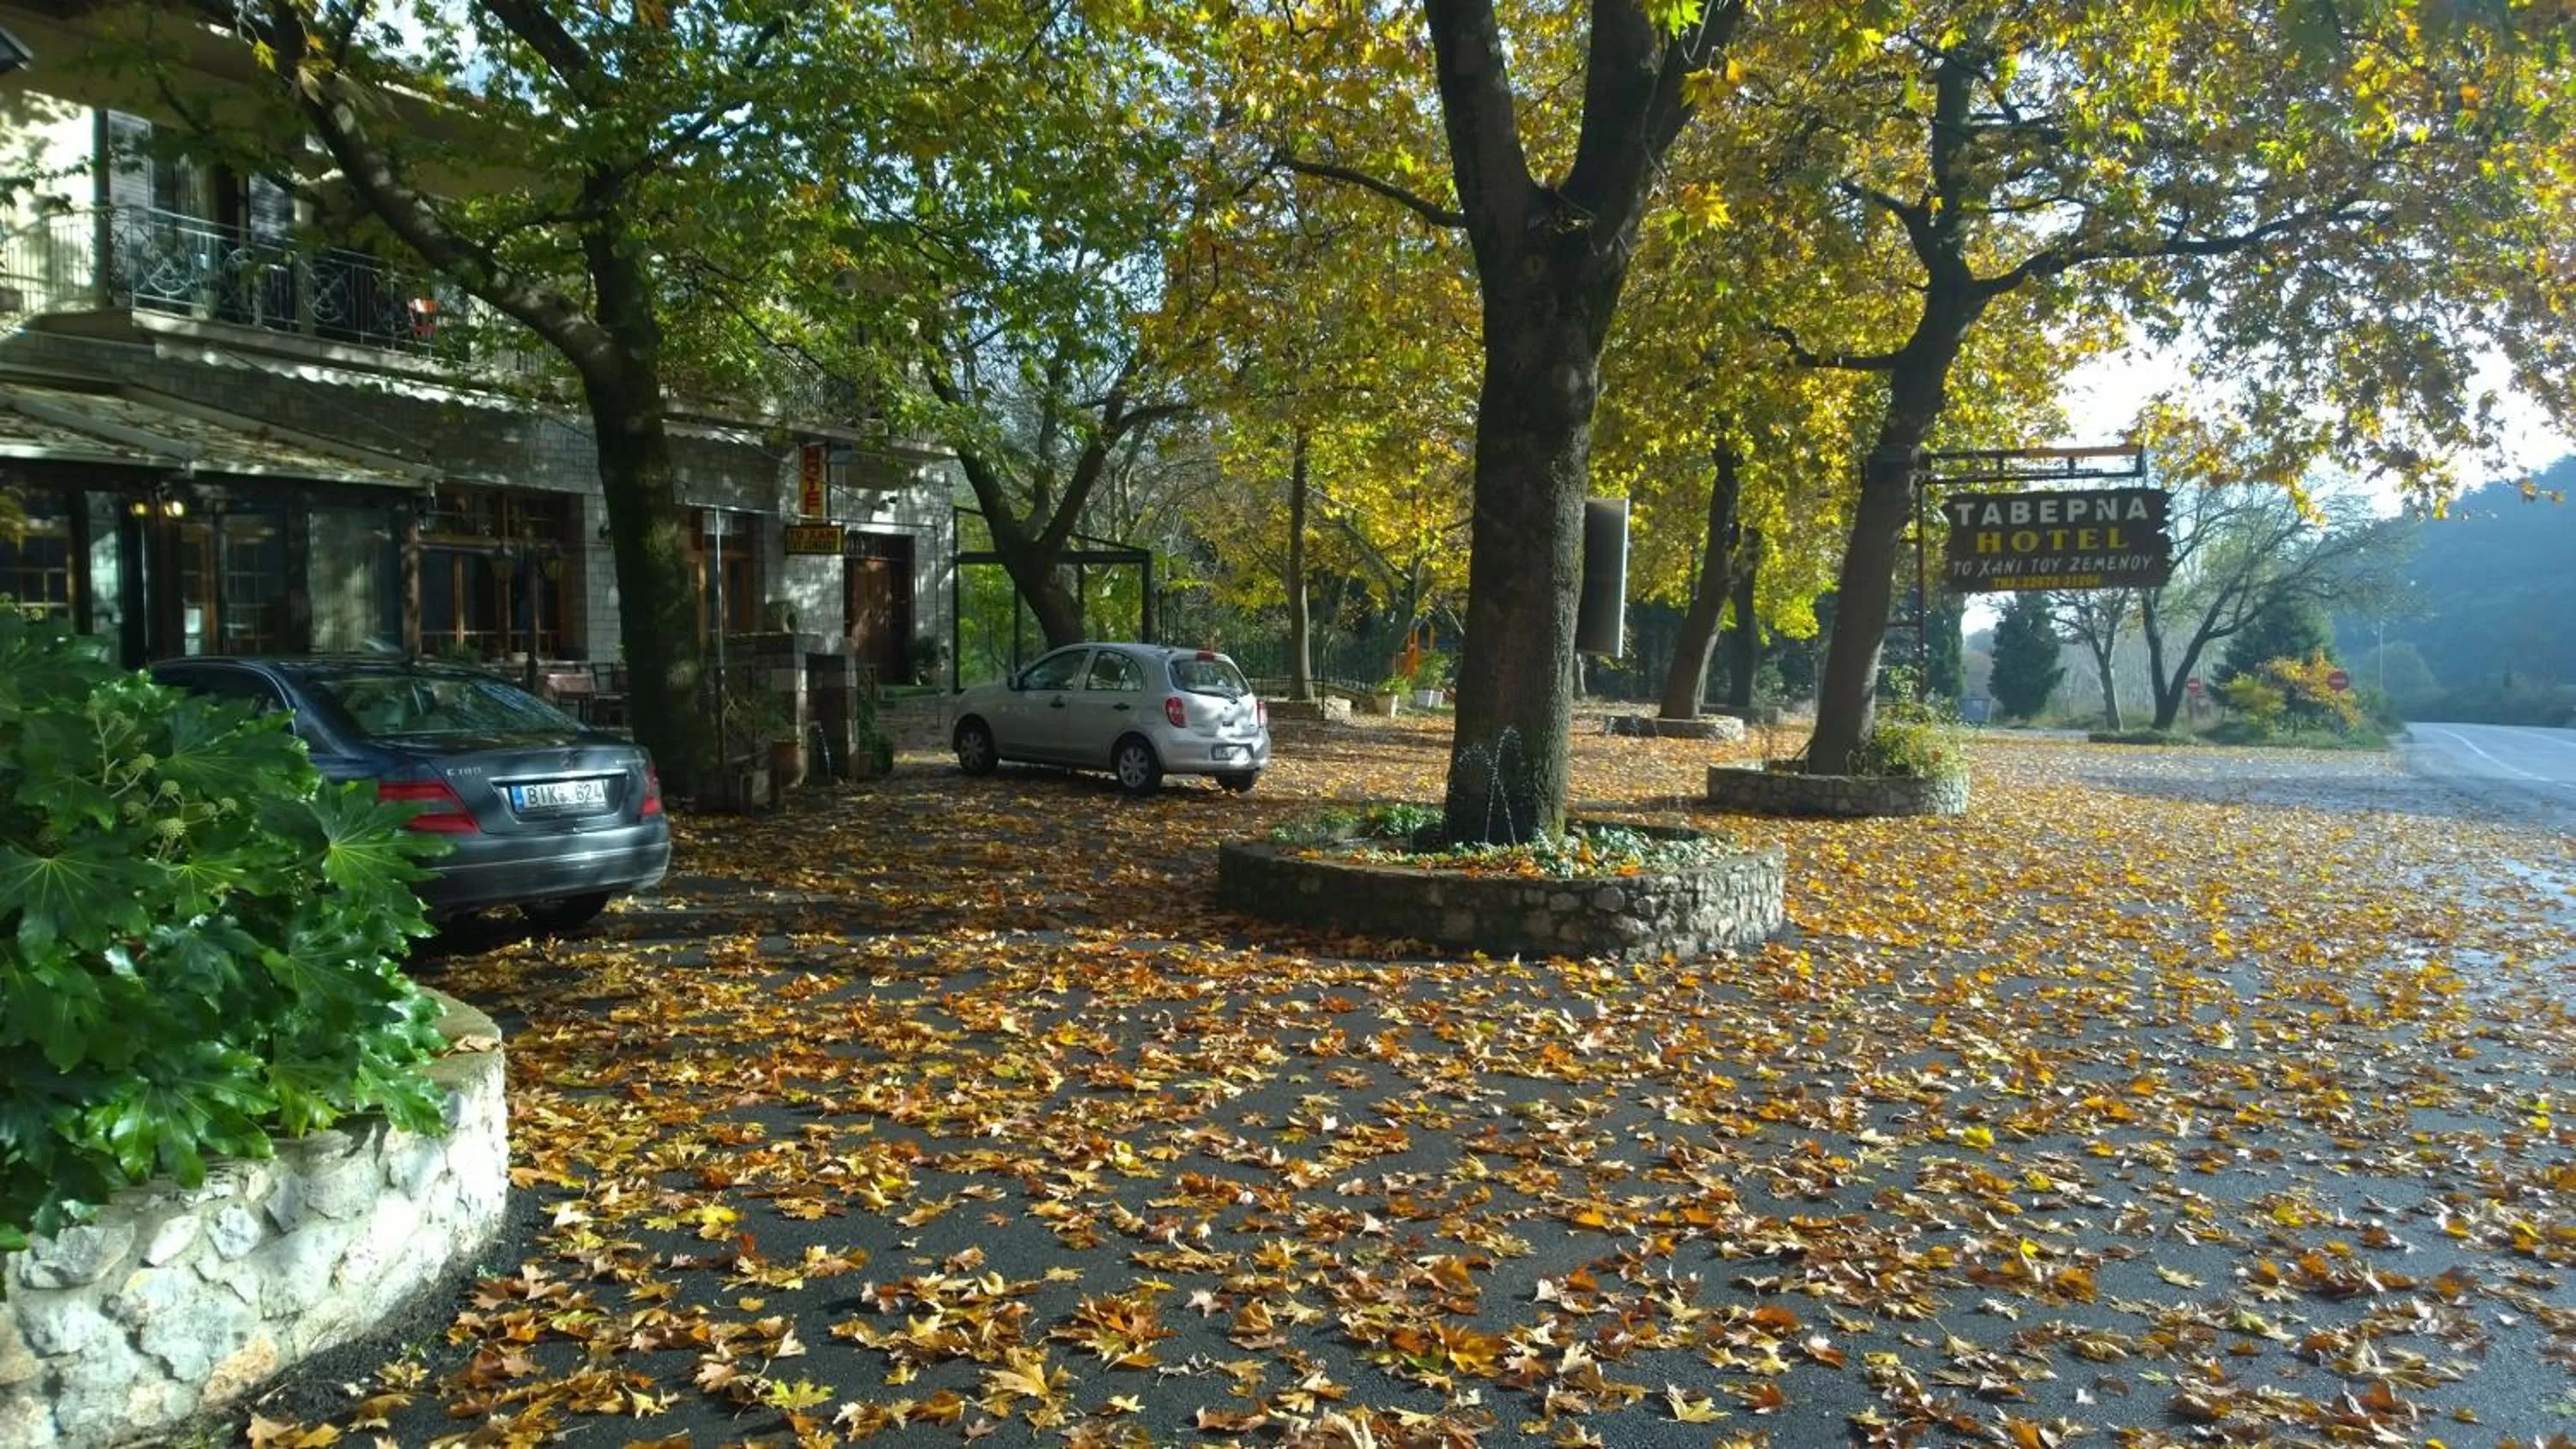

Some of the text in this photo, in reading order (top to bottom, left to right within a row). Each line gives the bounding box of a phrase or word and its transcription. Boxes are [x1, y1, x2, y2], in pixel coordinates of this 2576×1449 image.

[1954, 496, 2149, 526] ΤΑΒΕΡΝΑ
[1976, 527, 2130, 554] HOTEL
[1953, 554, 2154, 578] ΤΟ ΧΑΝΙ ΤΟΥ ΖΕΜΕΝΟΥ
